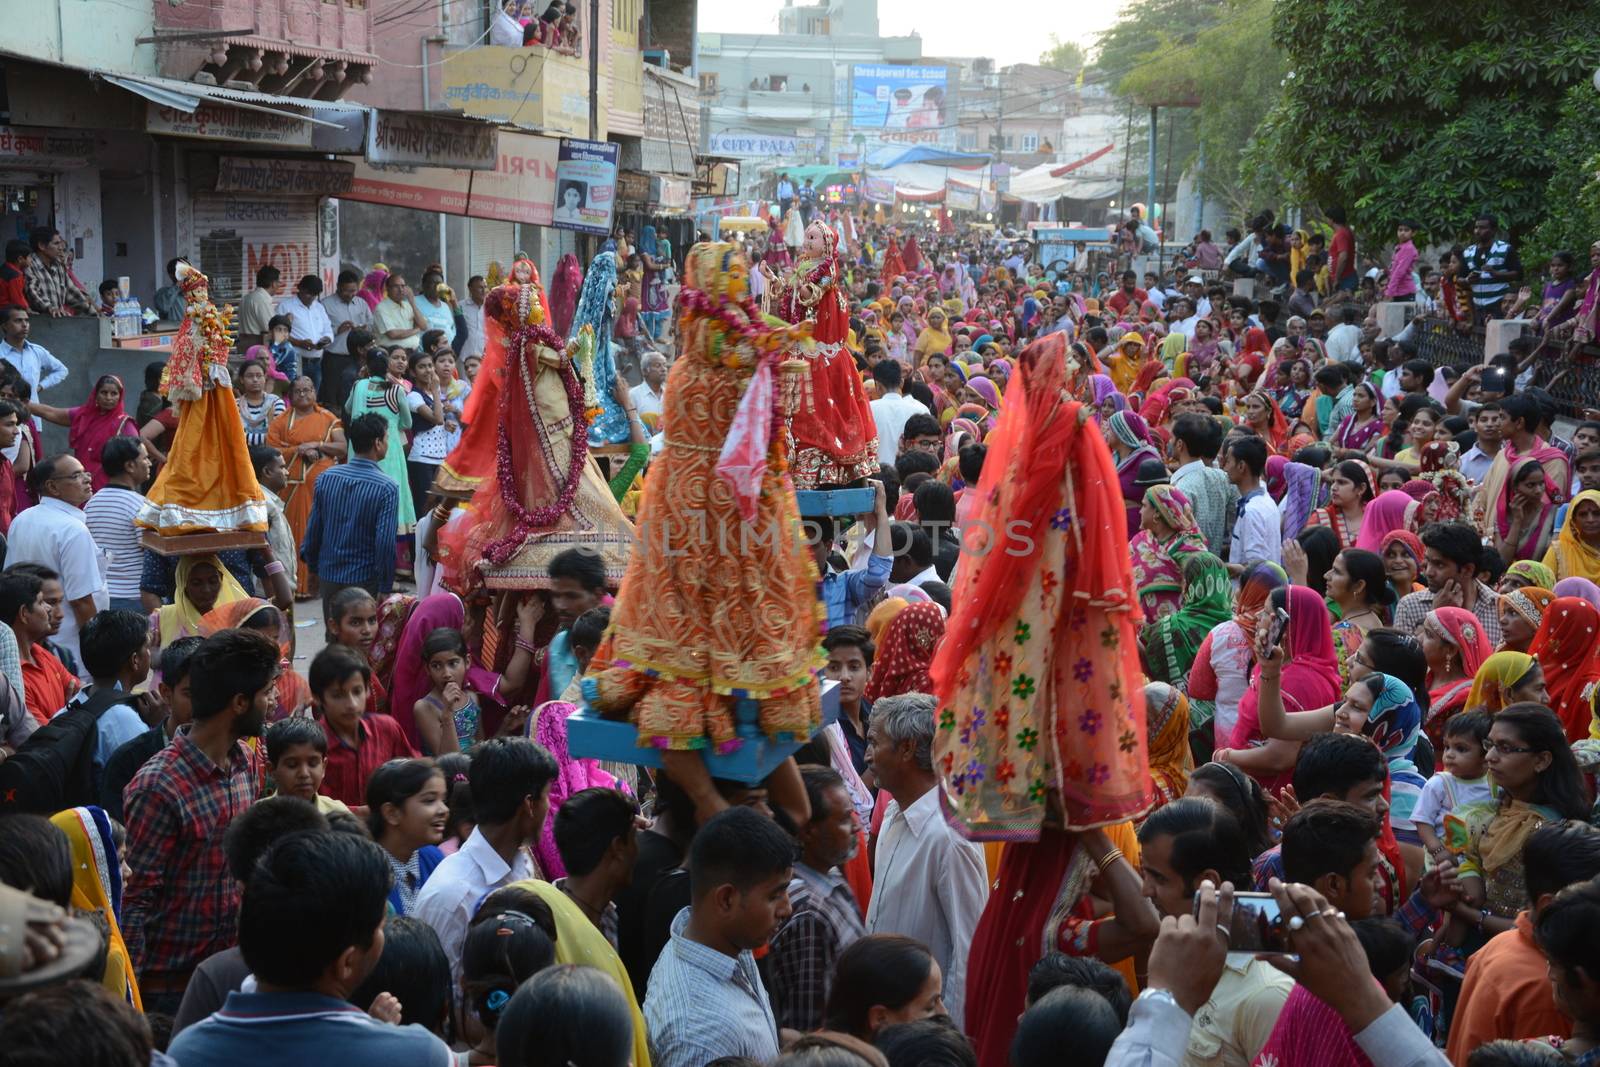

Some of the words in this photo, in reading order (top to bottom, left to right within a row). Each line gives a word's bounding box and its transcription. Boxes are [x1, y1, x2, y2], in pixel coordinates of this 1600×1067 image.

[922, 68, 946, 80] School
[722, 139, 753, 152] CITY
[246, 241, 309, 296] MODI
